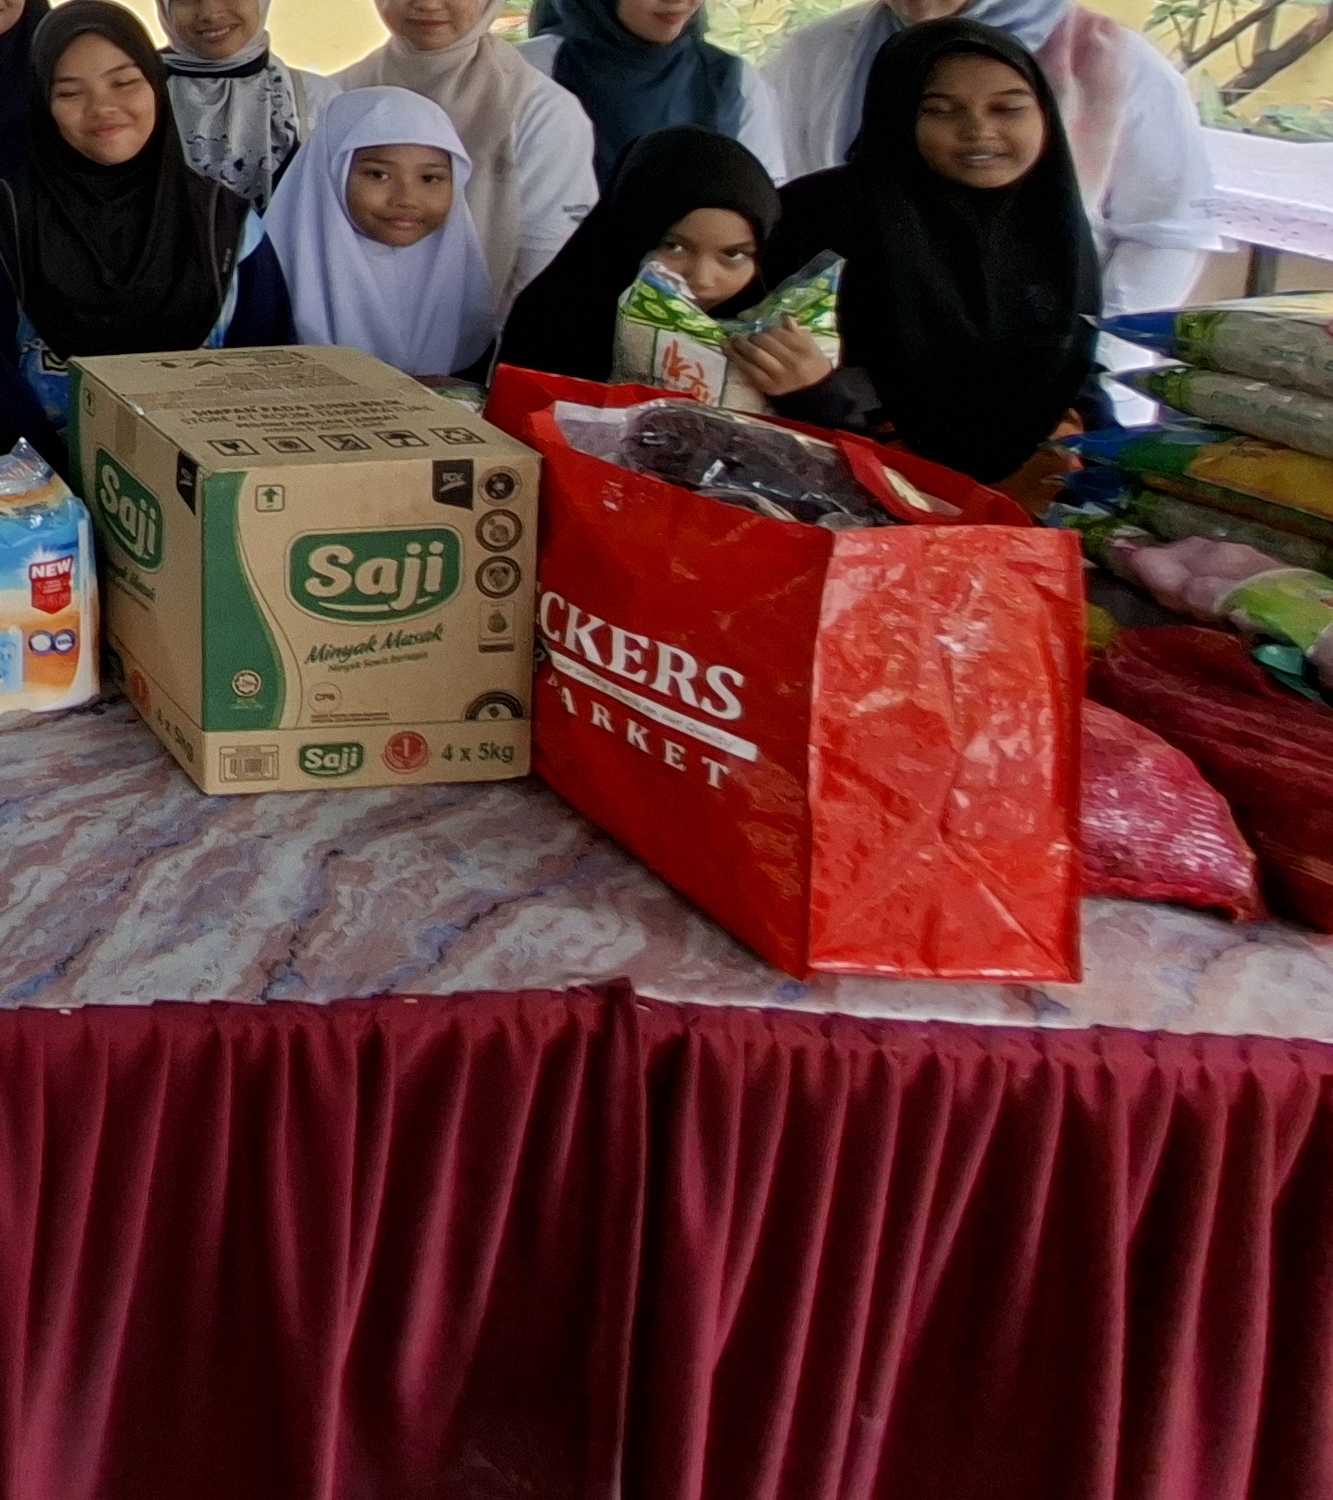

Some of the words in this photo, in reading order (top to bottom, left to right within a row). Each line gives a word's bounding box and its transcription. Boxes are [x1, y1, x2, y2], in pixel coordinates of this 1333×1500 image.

[99, 464, 157, 560] Saji
[31, 557, 74, 579] NEW
[305, 541, 445, 611] Saji
[304, 633, 378, 666] Minyak
[539, 591, 745, 721] CKERS
[441, 743, 453, 762] 4
[458, 747, 472, 762] x
[478, 740, 515, 764] 5kg
[546, 672, 733, 790] ARKET
[305, 747, 359, 770] Saji
